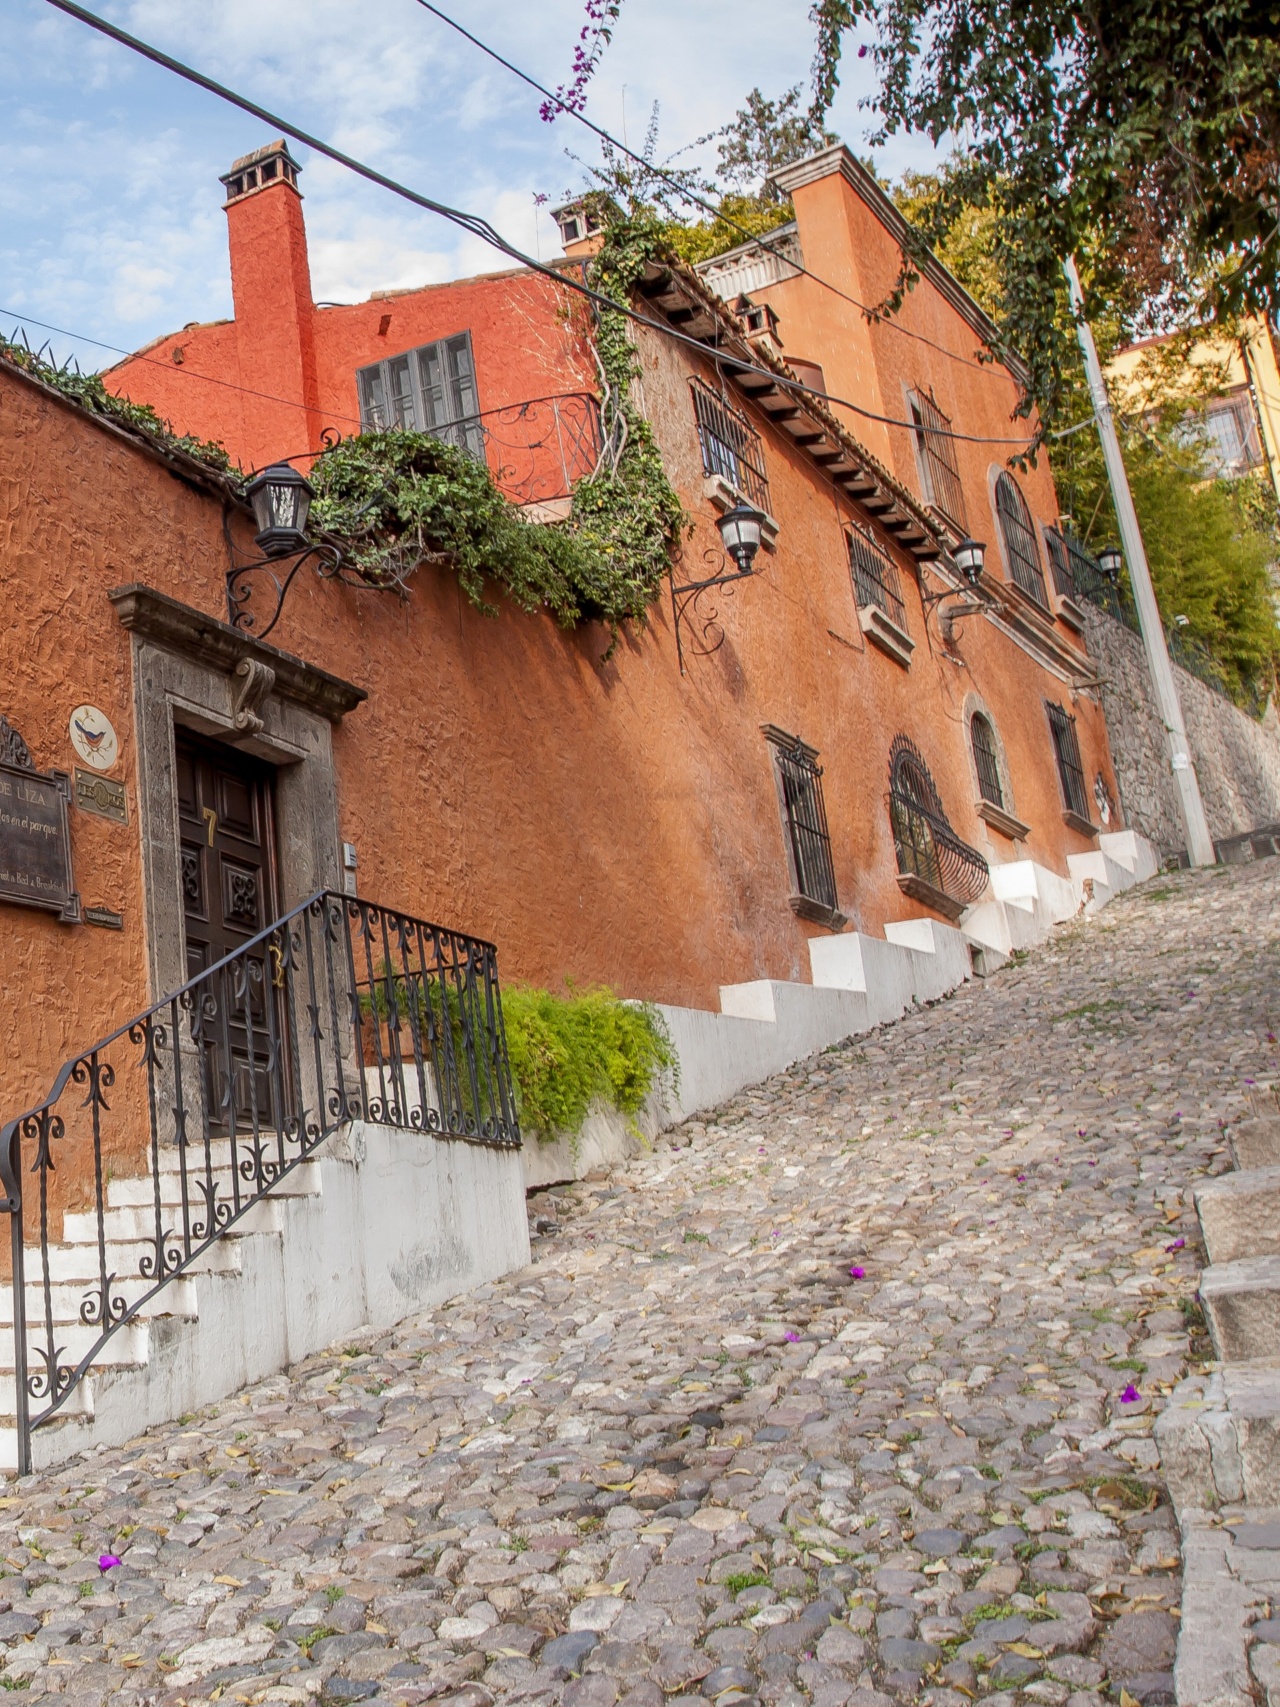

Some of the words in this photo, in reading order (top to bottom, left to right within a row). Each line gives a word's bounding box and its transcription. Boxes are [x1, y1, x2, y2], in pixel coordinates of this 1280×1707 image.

[17, 786, 46, 806] LIZA
[11, 816, 20, 826] en
[21, 815, 29, 828] el
[202, 806, 217, 848] 7
[10, 875, 16, 883] a
[16, 872, 29, 886] Bed
[30, 879, 35, 887] &
[35, 876, 65, 893] Breakfast
